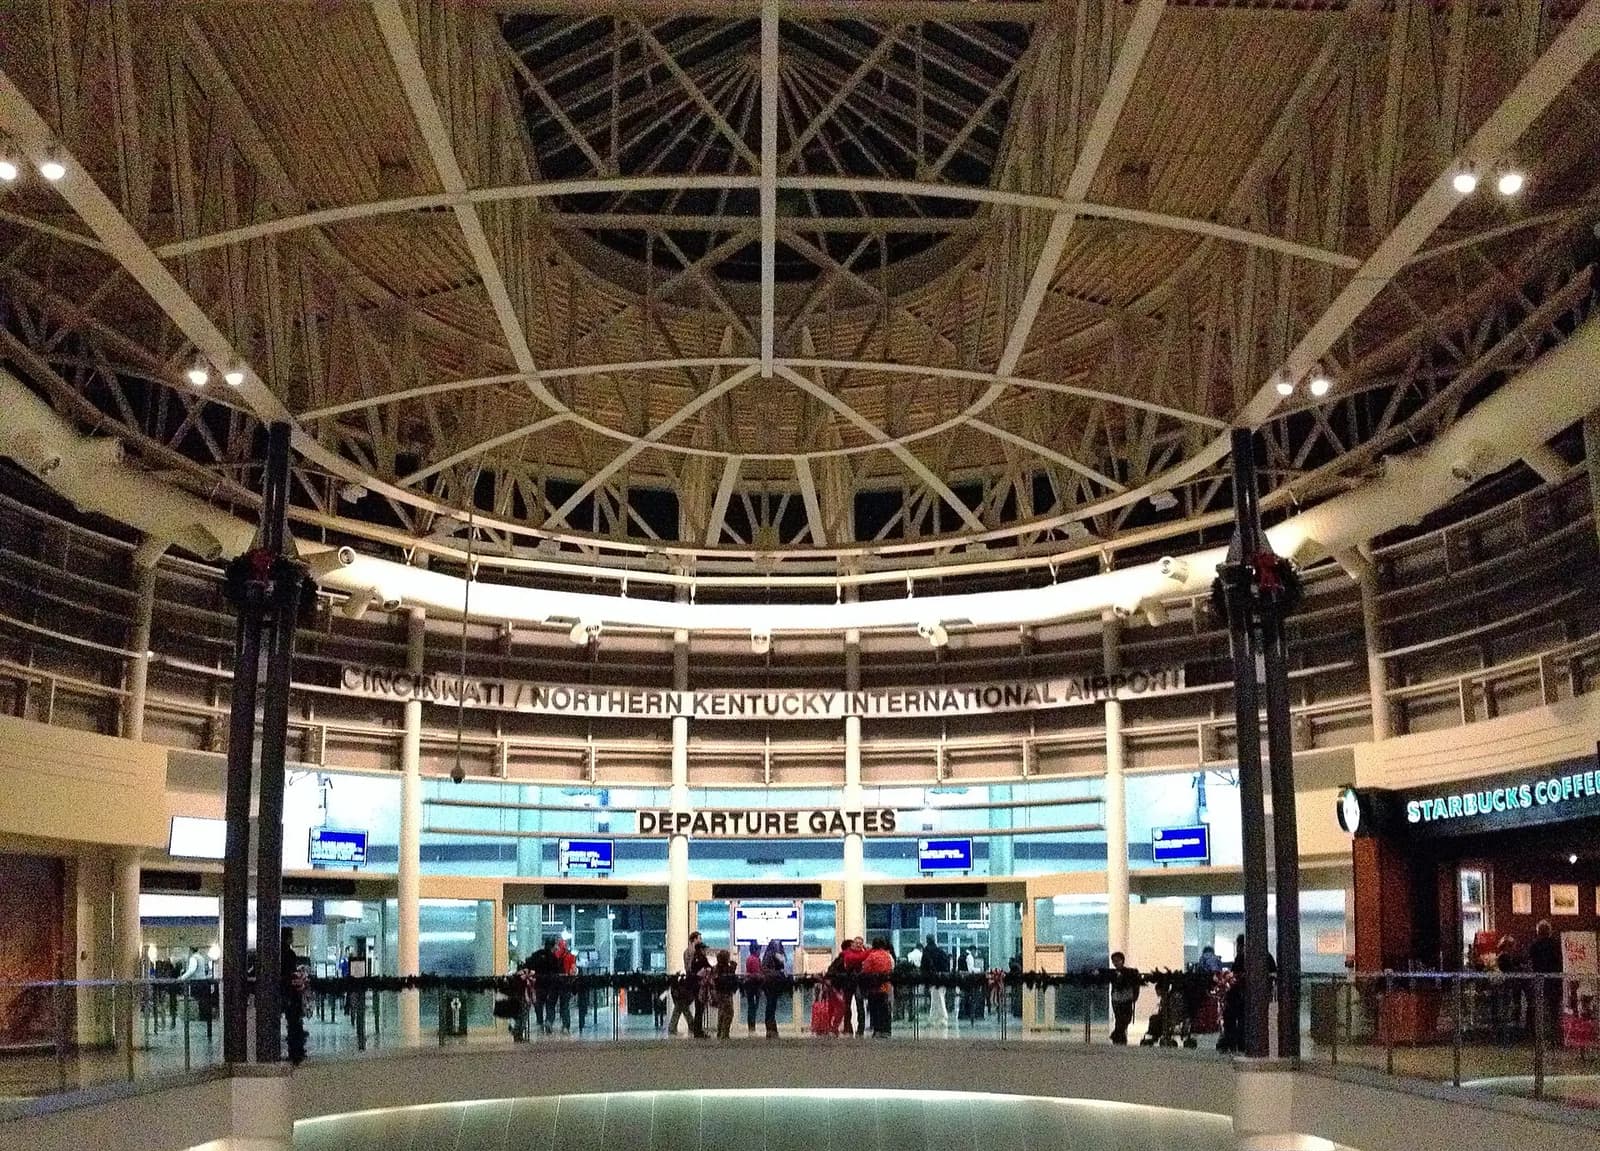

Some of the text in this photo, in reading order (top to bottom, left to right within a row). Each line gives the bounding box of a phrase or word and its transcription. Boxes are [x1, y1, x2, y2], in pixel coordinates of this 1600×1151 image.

[343, 666, 504, 705] CINCINNATI
[531, 685, 682, 714] NORTHERN
[693, 693, 836, 715] KENTUCKY
[844, 683, 1057, 714] INTERNATIONAL
[639, 809, 896, 834] DEPARTURE GATES
[1407, 784, 1532, 823] STARBUCKS
